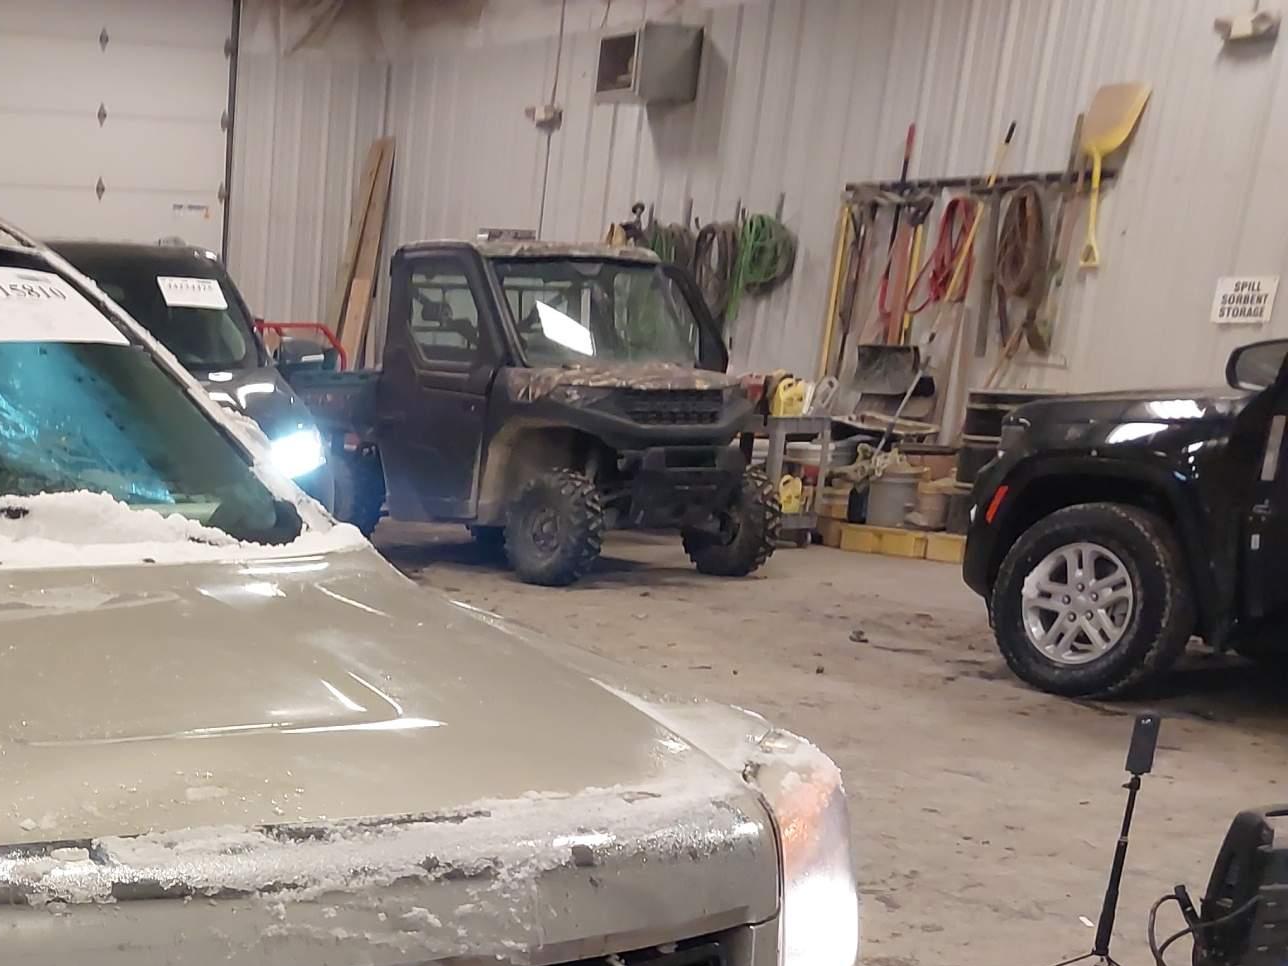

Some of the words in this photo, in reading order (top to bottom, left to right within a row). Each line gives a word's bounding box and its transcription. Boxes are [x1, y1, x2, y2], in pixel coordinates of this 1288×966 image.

[1234, 281, 1261, 292] SPILL
[1220, 293, 1269, 305] SORBENT
[1218, 306, 1264, 318] STORAGE
